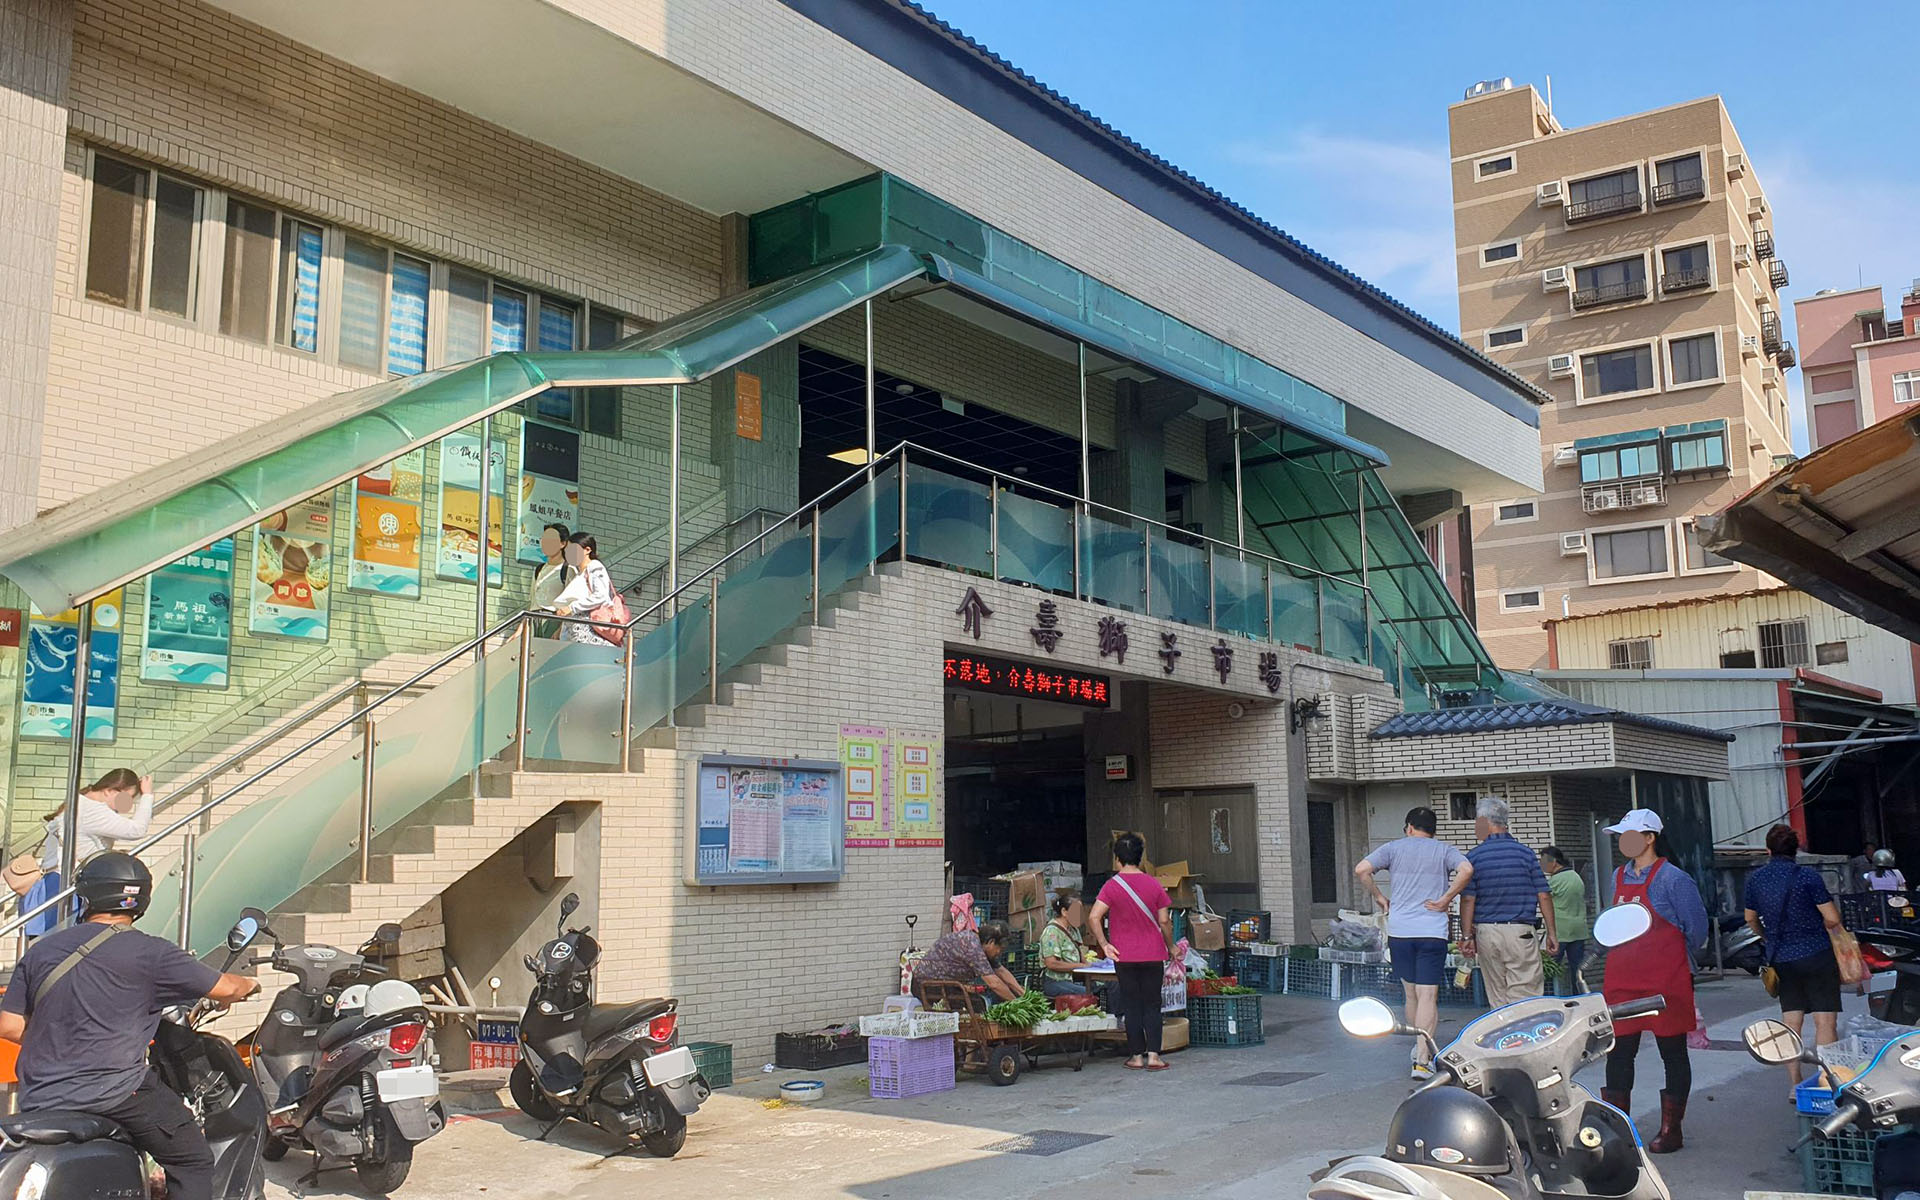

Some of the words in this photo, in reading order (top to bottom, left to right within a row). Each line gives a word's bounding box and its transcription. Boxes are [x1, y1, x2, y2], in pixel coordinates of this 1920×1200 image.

[174, 601, 208, 614] 馬祖
[955, 586, 1282, 693] 介壽獅子市場
